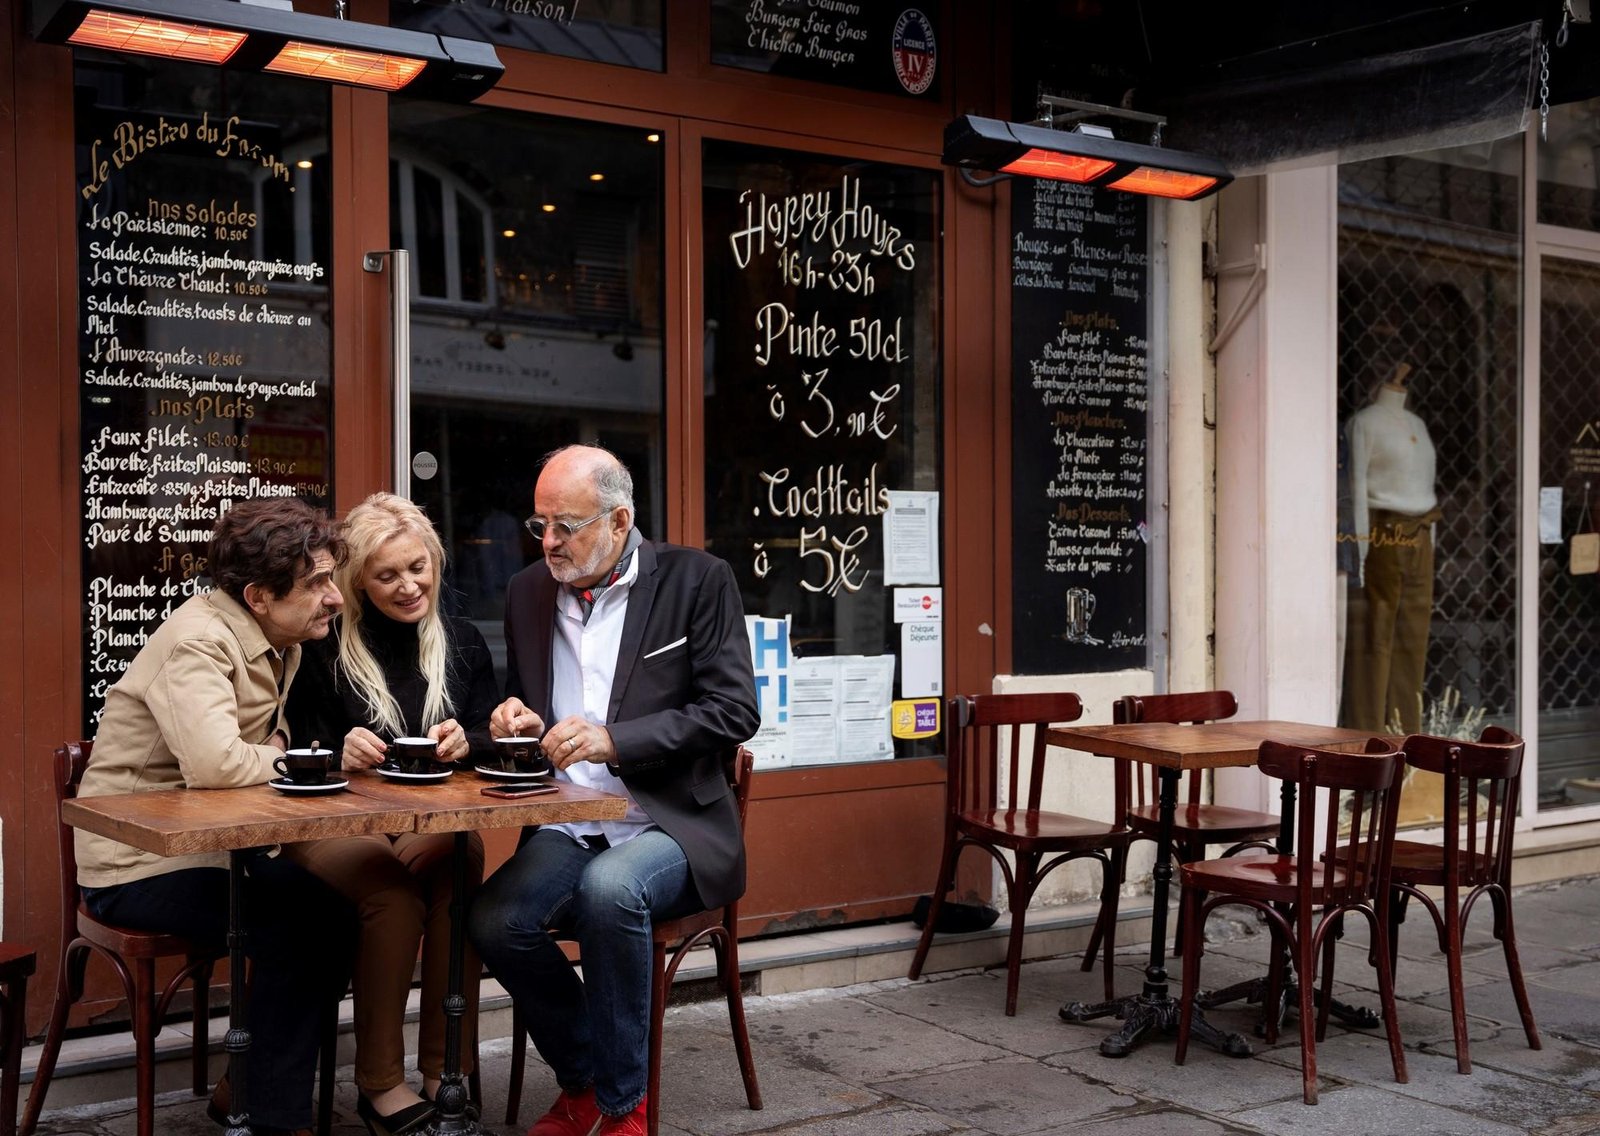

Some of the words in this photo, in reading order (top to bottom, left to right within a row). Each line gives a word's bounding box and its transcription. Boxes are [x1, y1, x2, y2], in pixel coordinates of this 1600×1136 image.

[908, 53, 924, 73] IV
[82, 139, 109, 199] Le
[113, 116, 188, 169] Bistro
[196, 112, 218, 143] du
[215, 226, 248, 240] 10.50€
[729, 189, 832, 269] Happy
[831, 175, 915, 270] Hours
[234, 281, 268, 295] 10.50€
[239, 304, 253, 323] de
[297, 316, 311, 326] au
[755, 302, 840, 365] Pinte
[850, 317, 909, 362] 50cl
[234, 376, 248, 393] de
[1066, 391, 1077, 404] de
[759, 463, 892, 518] Cocktails
[1084, 483, 1094, 498] de
[86, 522, 131, 549] Pavé
[134, 523, 153, 544] de
[1078, 556, 1089, 571] du
[88, 575, 156, 607] Planche
[160, 577, 178, 597] de
[90, 600, 157, 631] Planche
[160, 599, 173, 621] d
[91, 626, 150, 655] Planch
